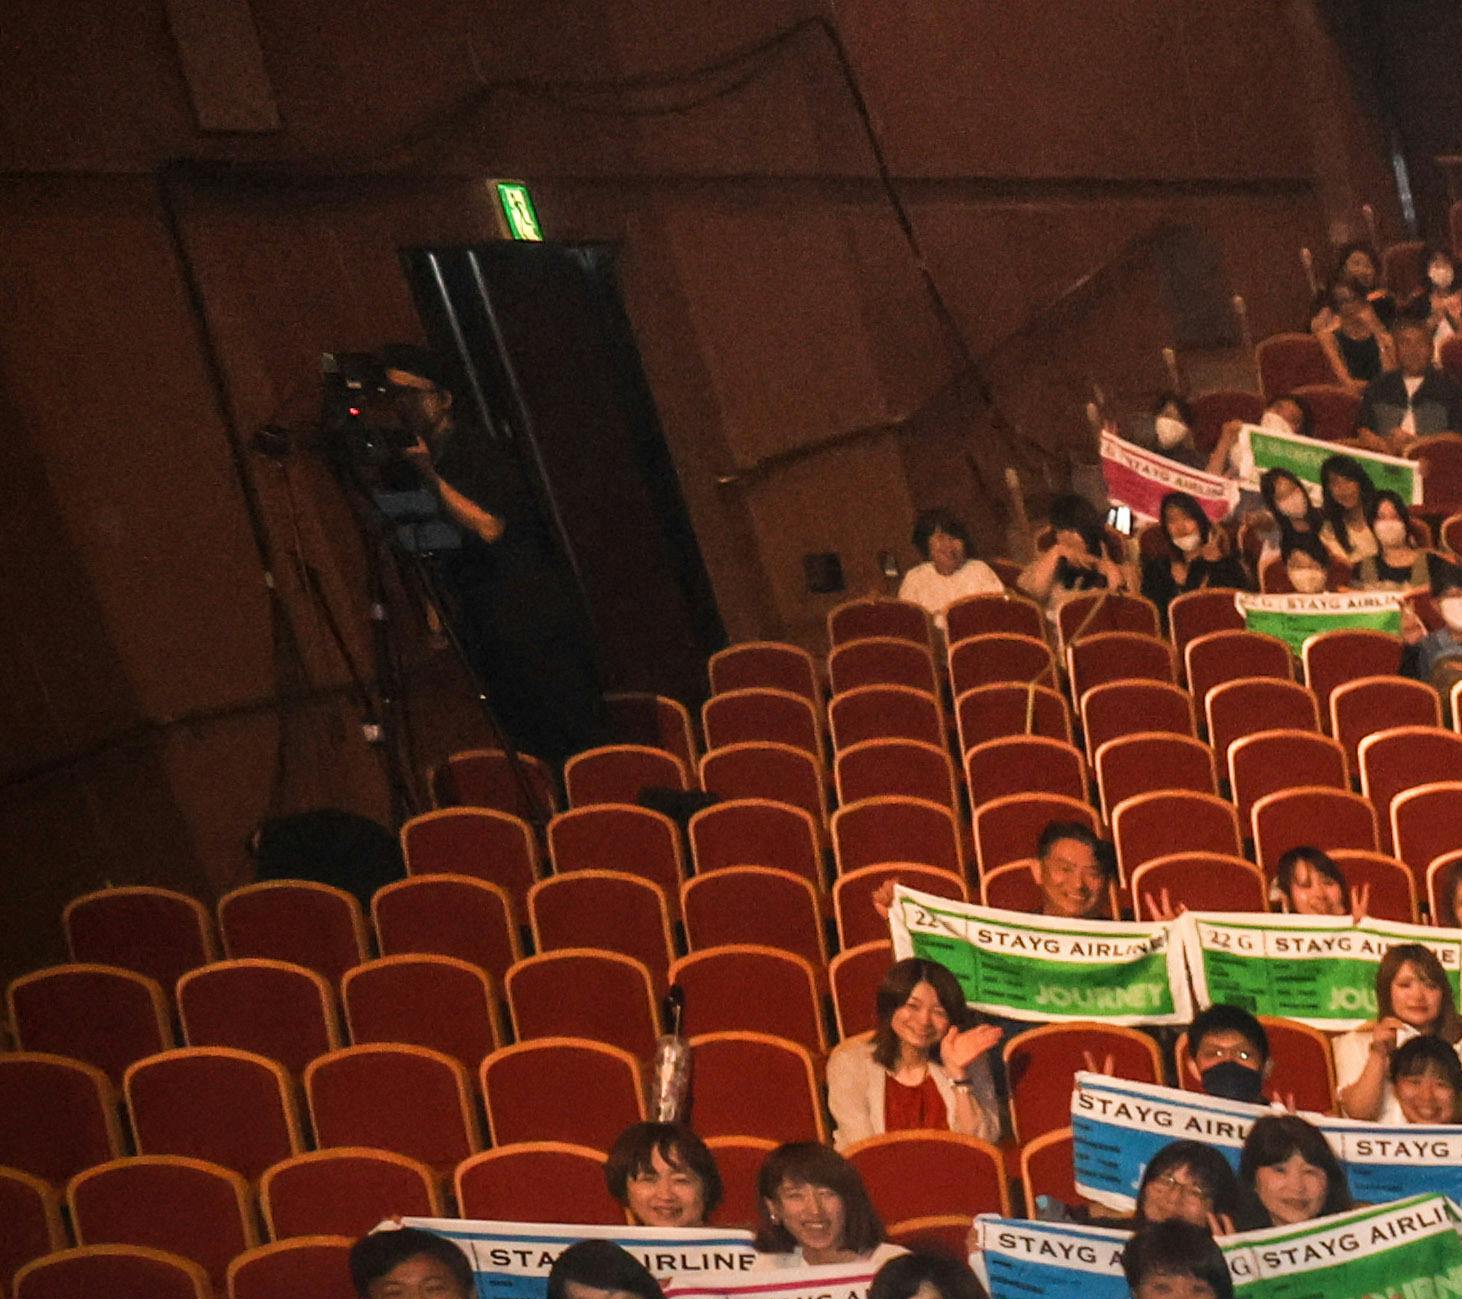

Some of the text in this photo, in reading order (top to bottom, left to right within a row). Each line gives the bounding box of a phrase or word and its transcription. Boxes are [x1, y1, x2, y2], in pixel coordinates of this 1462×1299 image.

[978, 928, 1061, 955] STAYG
[1275, 936, 1351, 954] STAYG
[1356, 1137, 1448, 1159] STAYG
